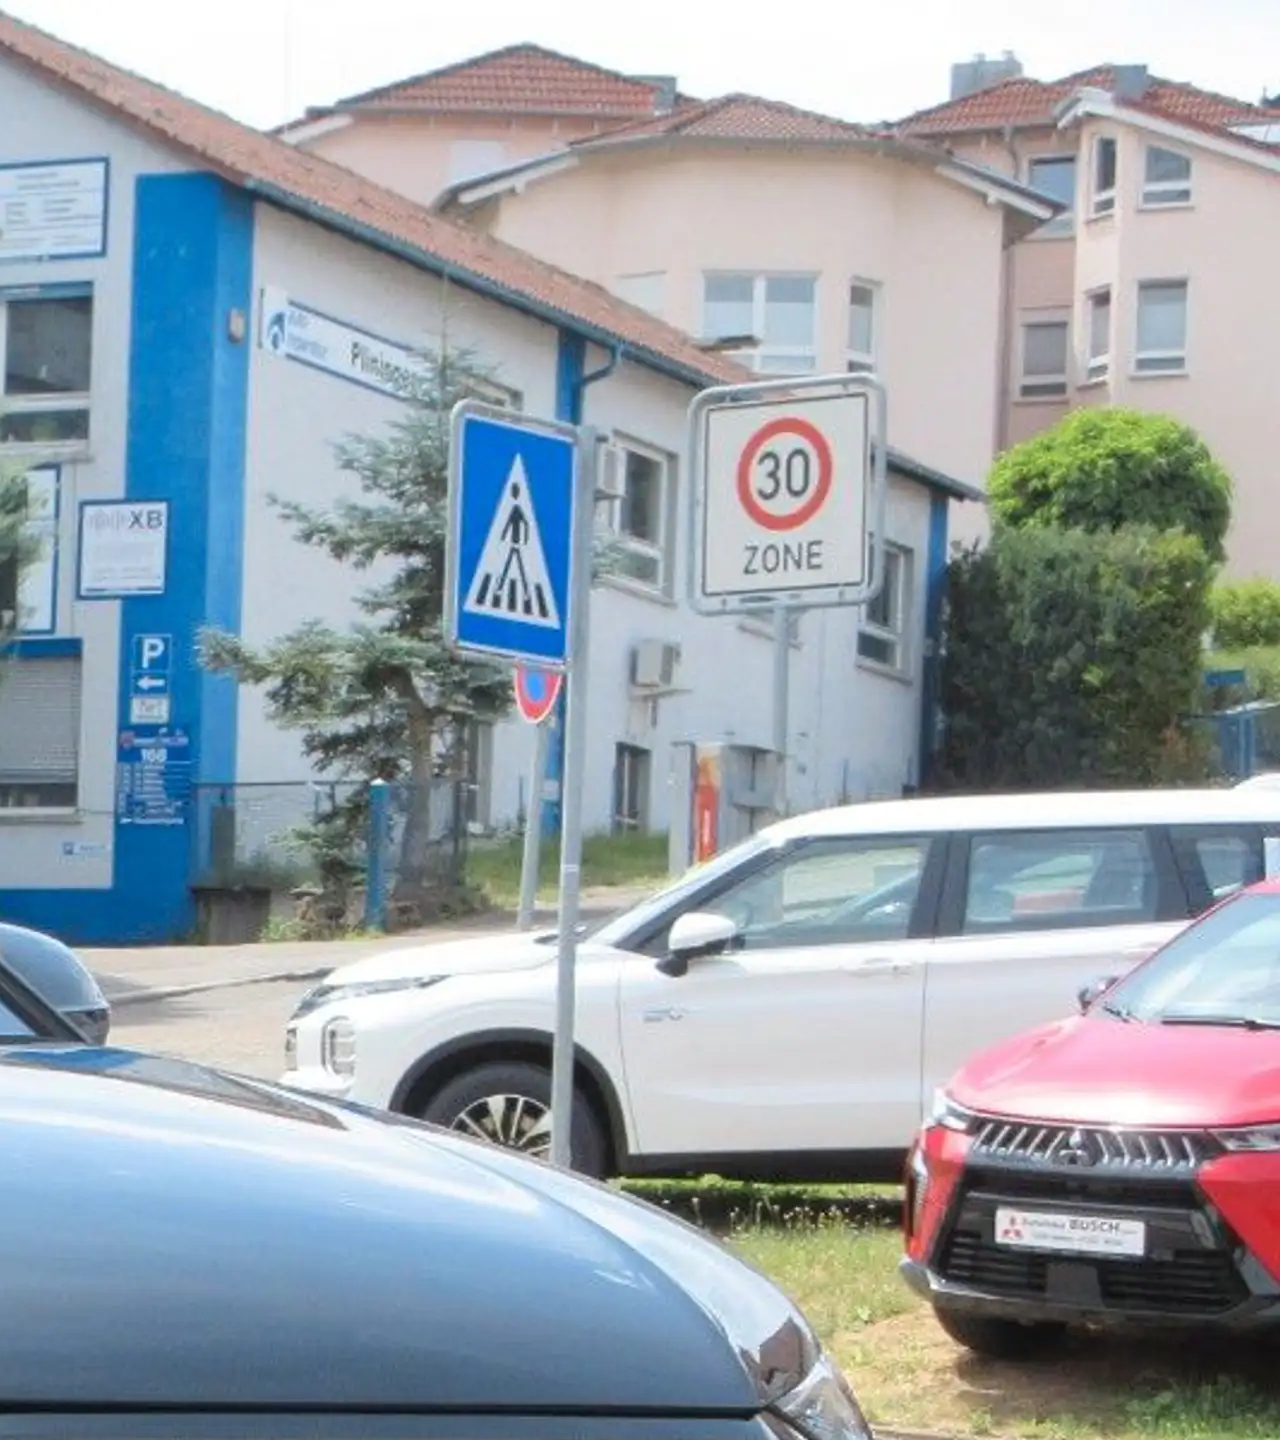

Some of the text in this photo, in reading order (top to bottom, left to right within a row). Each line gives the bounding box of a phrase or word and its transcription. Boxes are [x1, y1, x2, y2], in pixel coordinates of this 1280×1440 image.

[757, 448, 810, 501] 30
[743, 539, 823, 575] ZONE
[142, 637, 165, 669] P
